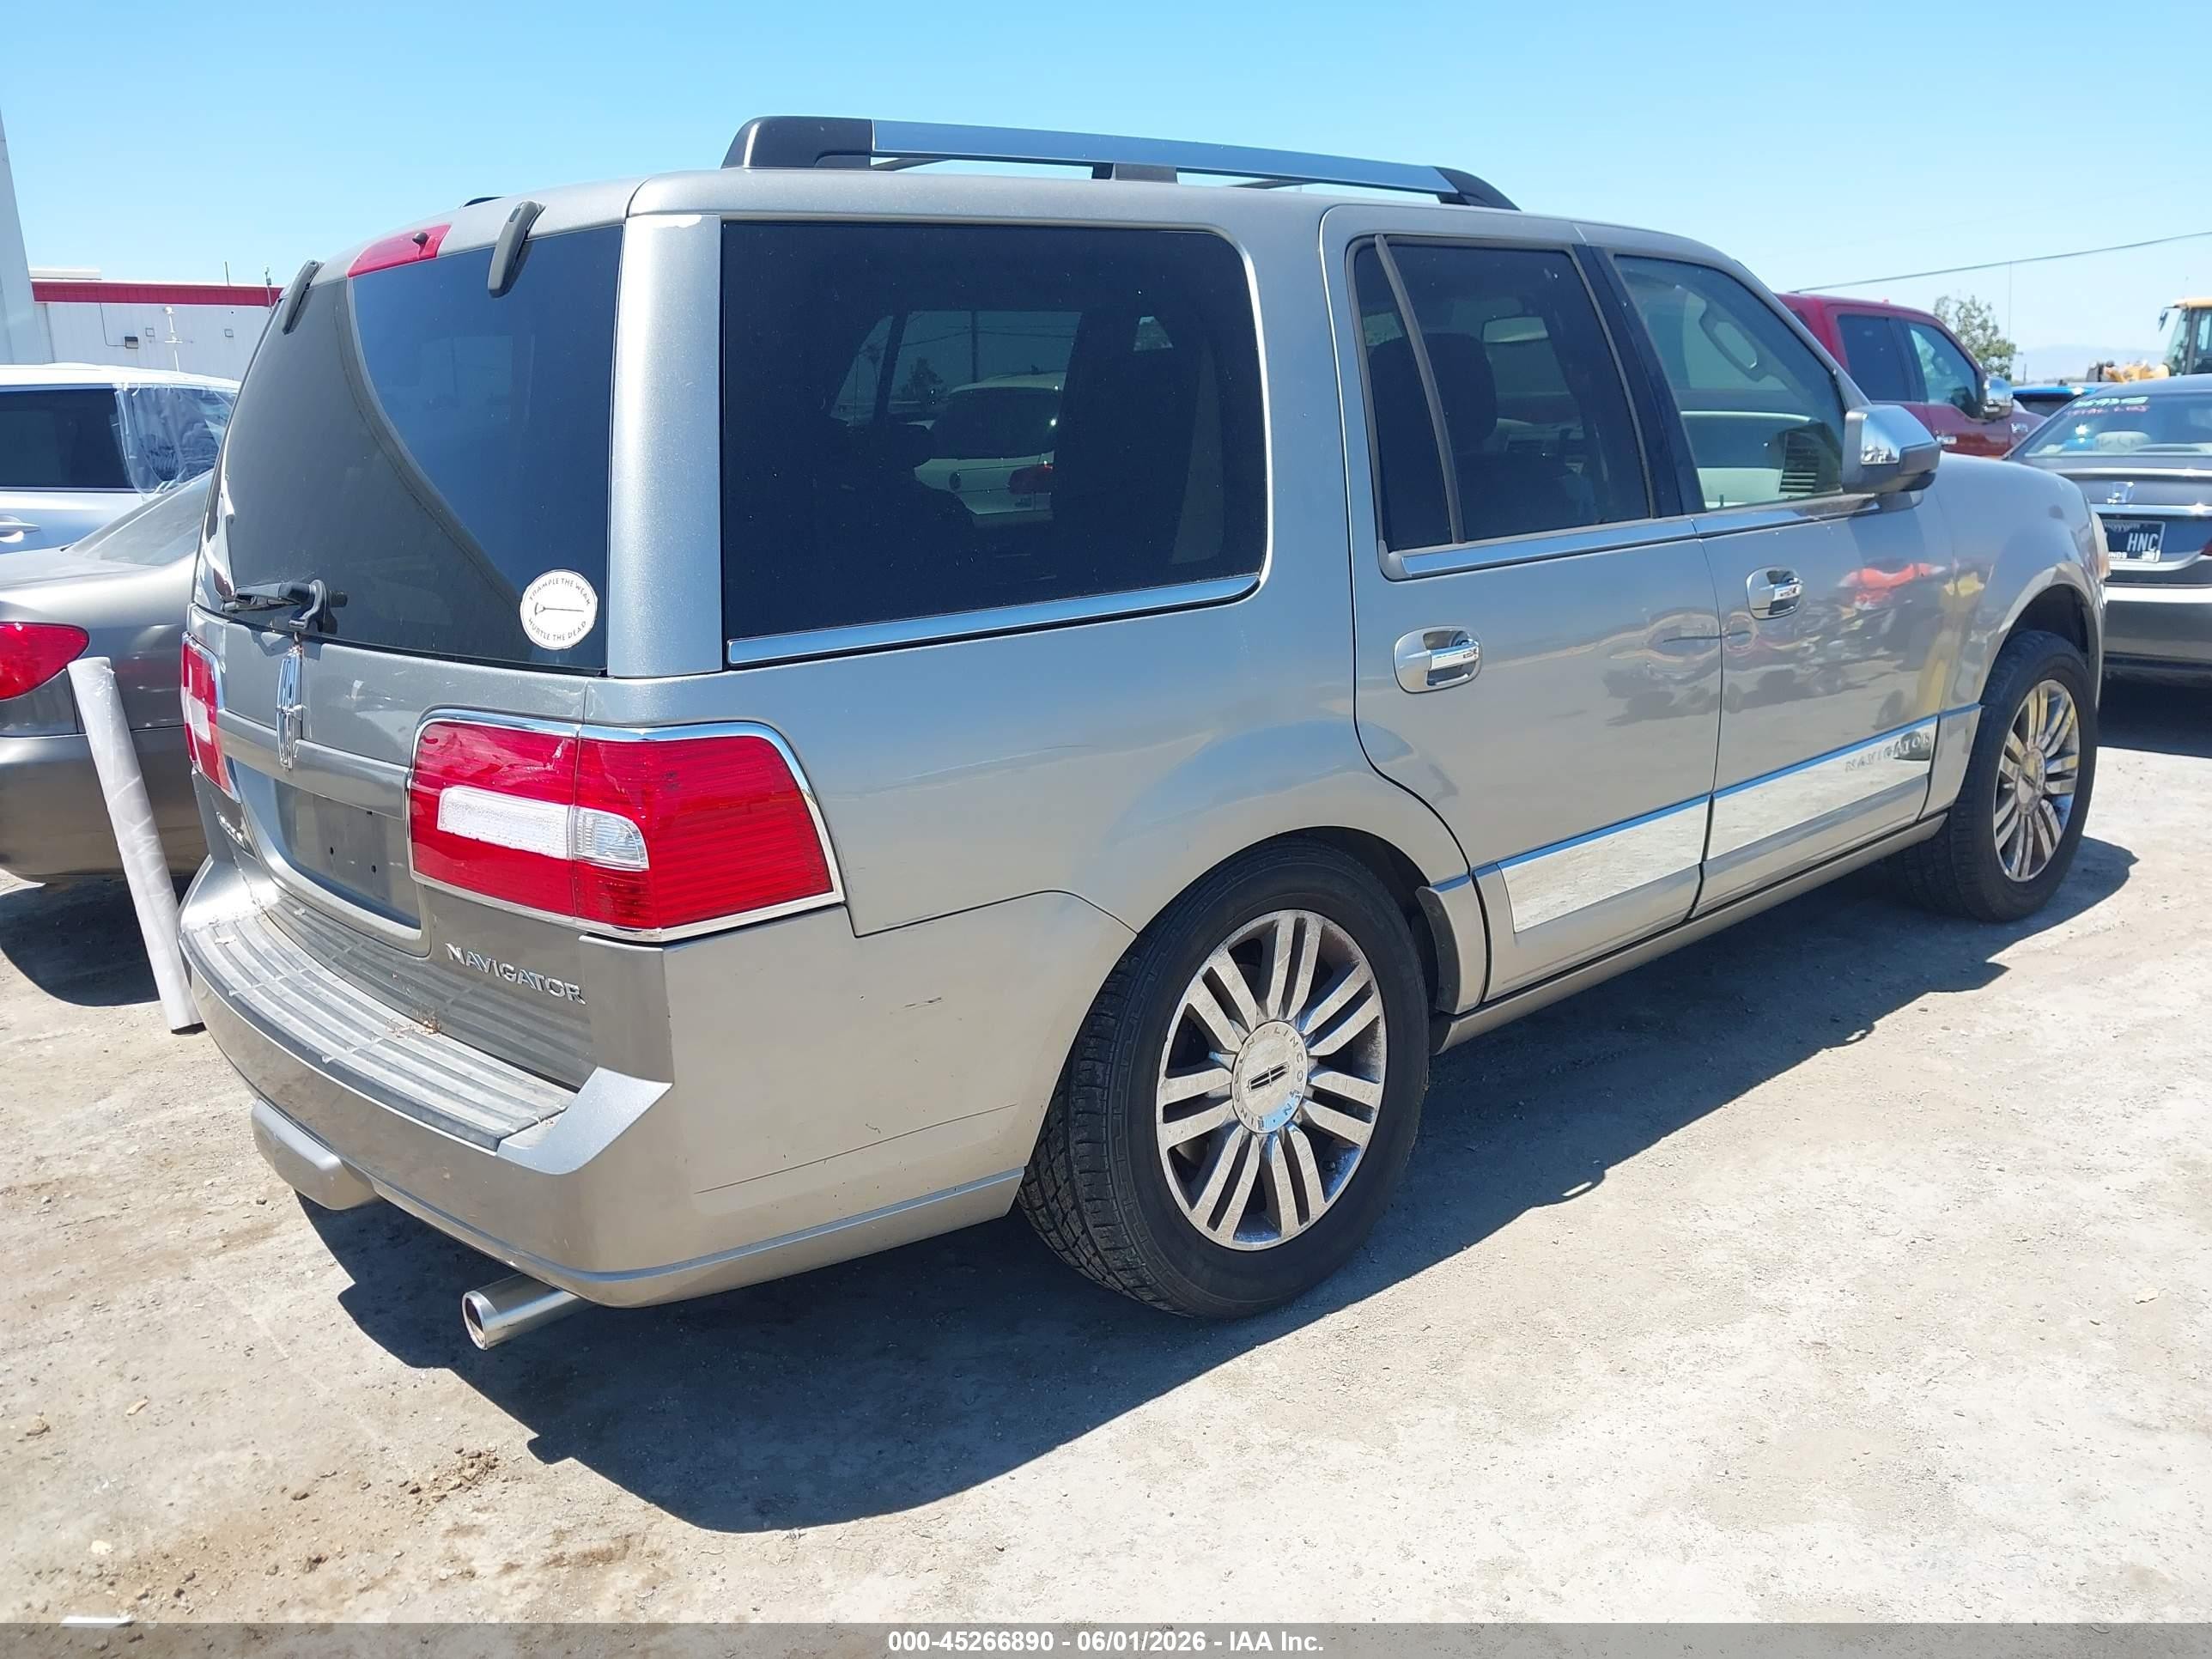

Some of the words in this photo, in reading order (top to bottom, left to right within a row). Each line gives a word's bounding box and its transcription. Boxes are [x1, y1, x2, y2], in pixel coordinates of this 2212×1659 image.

[2126, 532, 2159, 552] HNC
[529, 577, 560, 601] TRAMPLE
[561, 578, 574, 587] THE
[575, 582, 591, 606] WEAK
[528, 617, 550, 641] HURTLE
[568, 620, 586, 639] DEAD
[1844, 731, 1930, 773] NAVIGATOR
[445, 942, 587, 1006] NAVIGATOR
